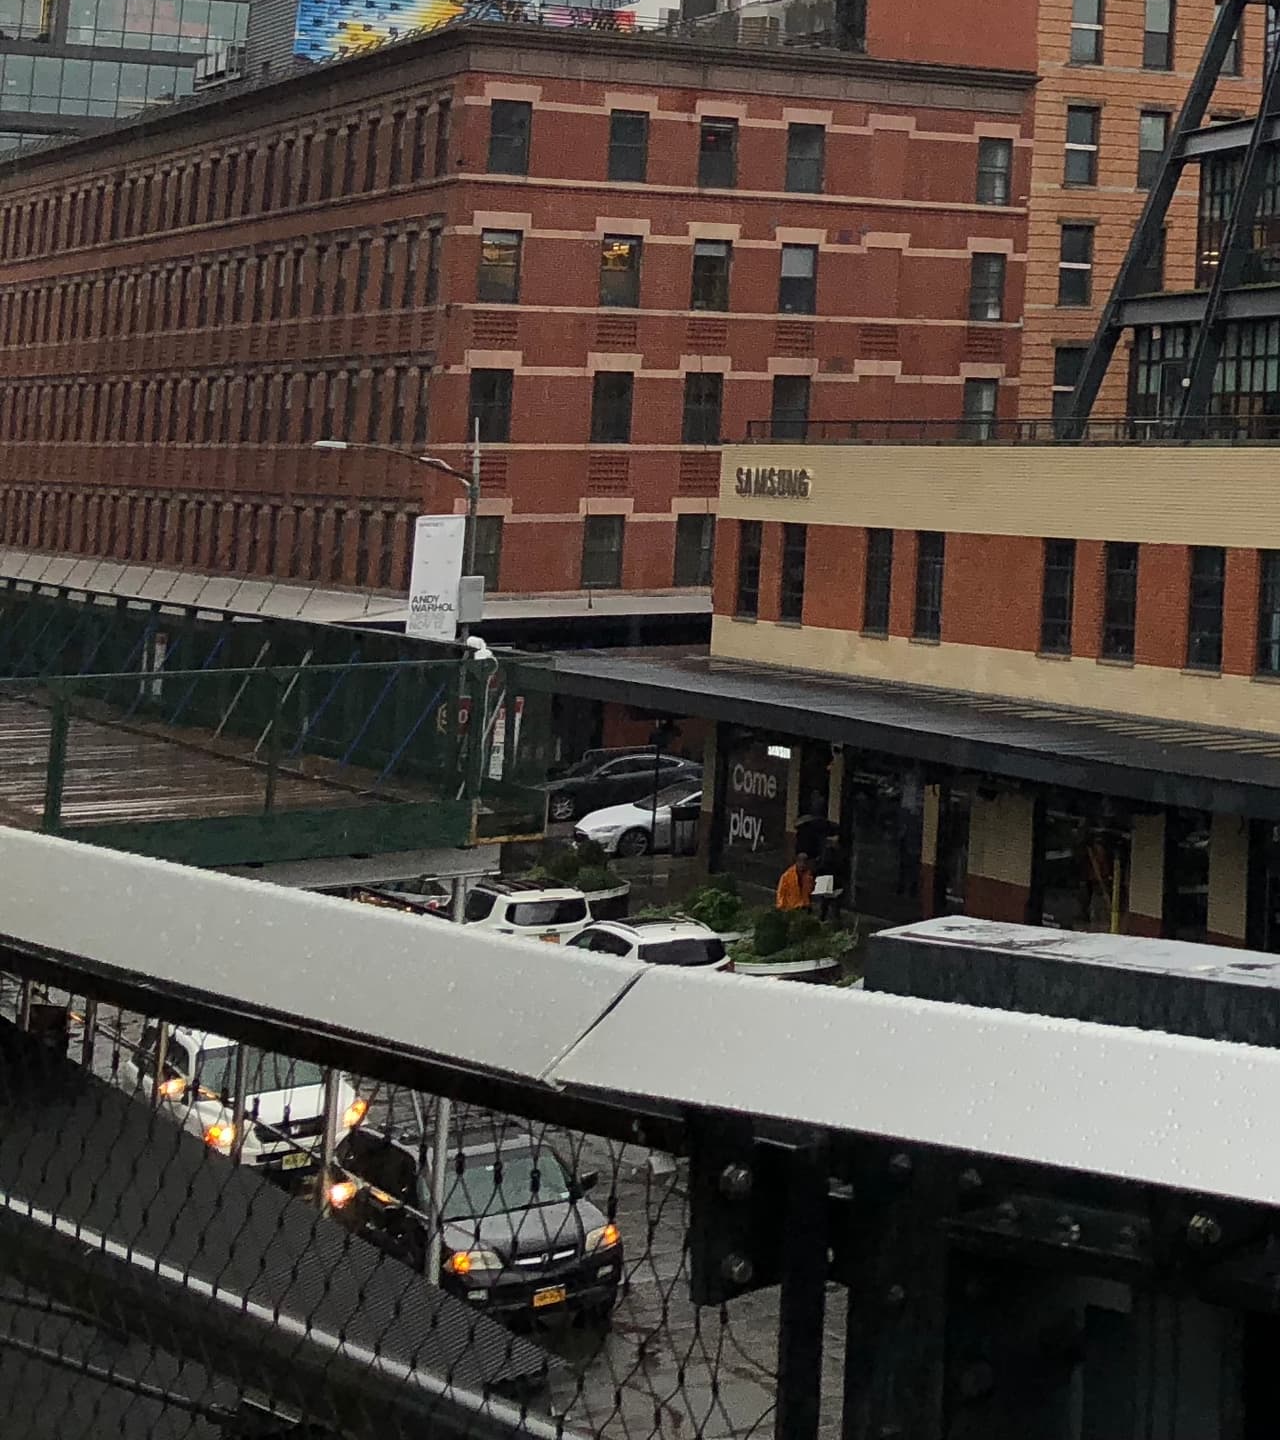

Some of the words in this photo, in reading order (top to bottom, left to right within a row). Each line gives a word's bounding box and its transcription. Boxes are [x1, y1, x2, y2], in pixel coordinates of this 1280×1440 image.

[735, 467, 810, 497] SAMSUNG
[411, 595, 440, 604] ANDY
[411, 603, 455, 612] WARHOL
[733, 763, 776, 798] Come
[729, 807, 764, 851] play.
